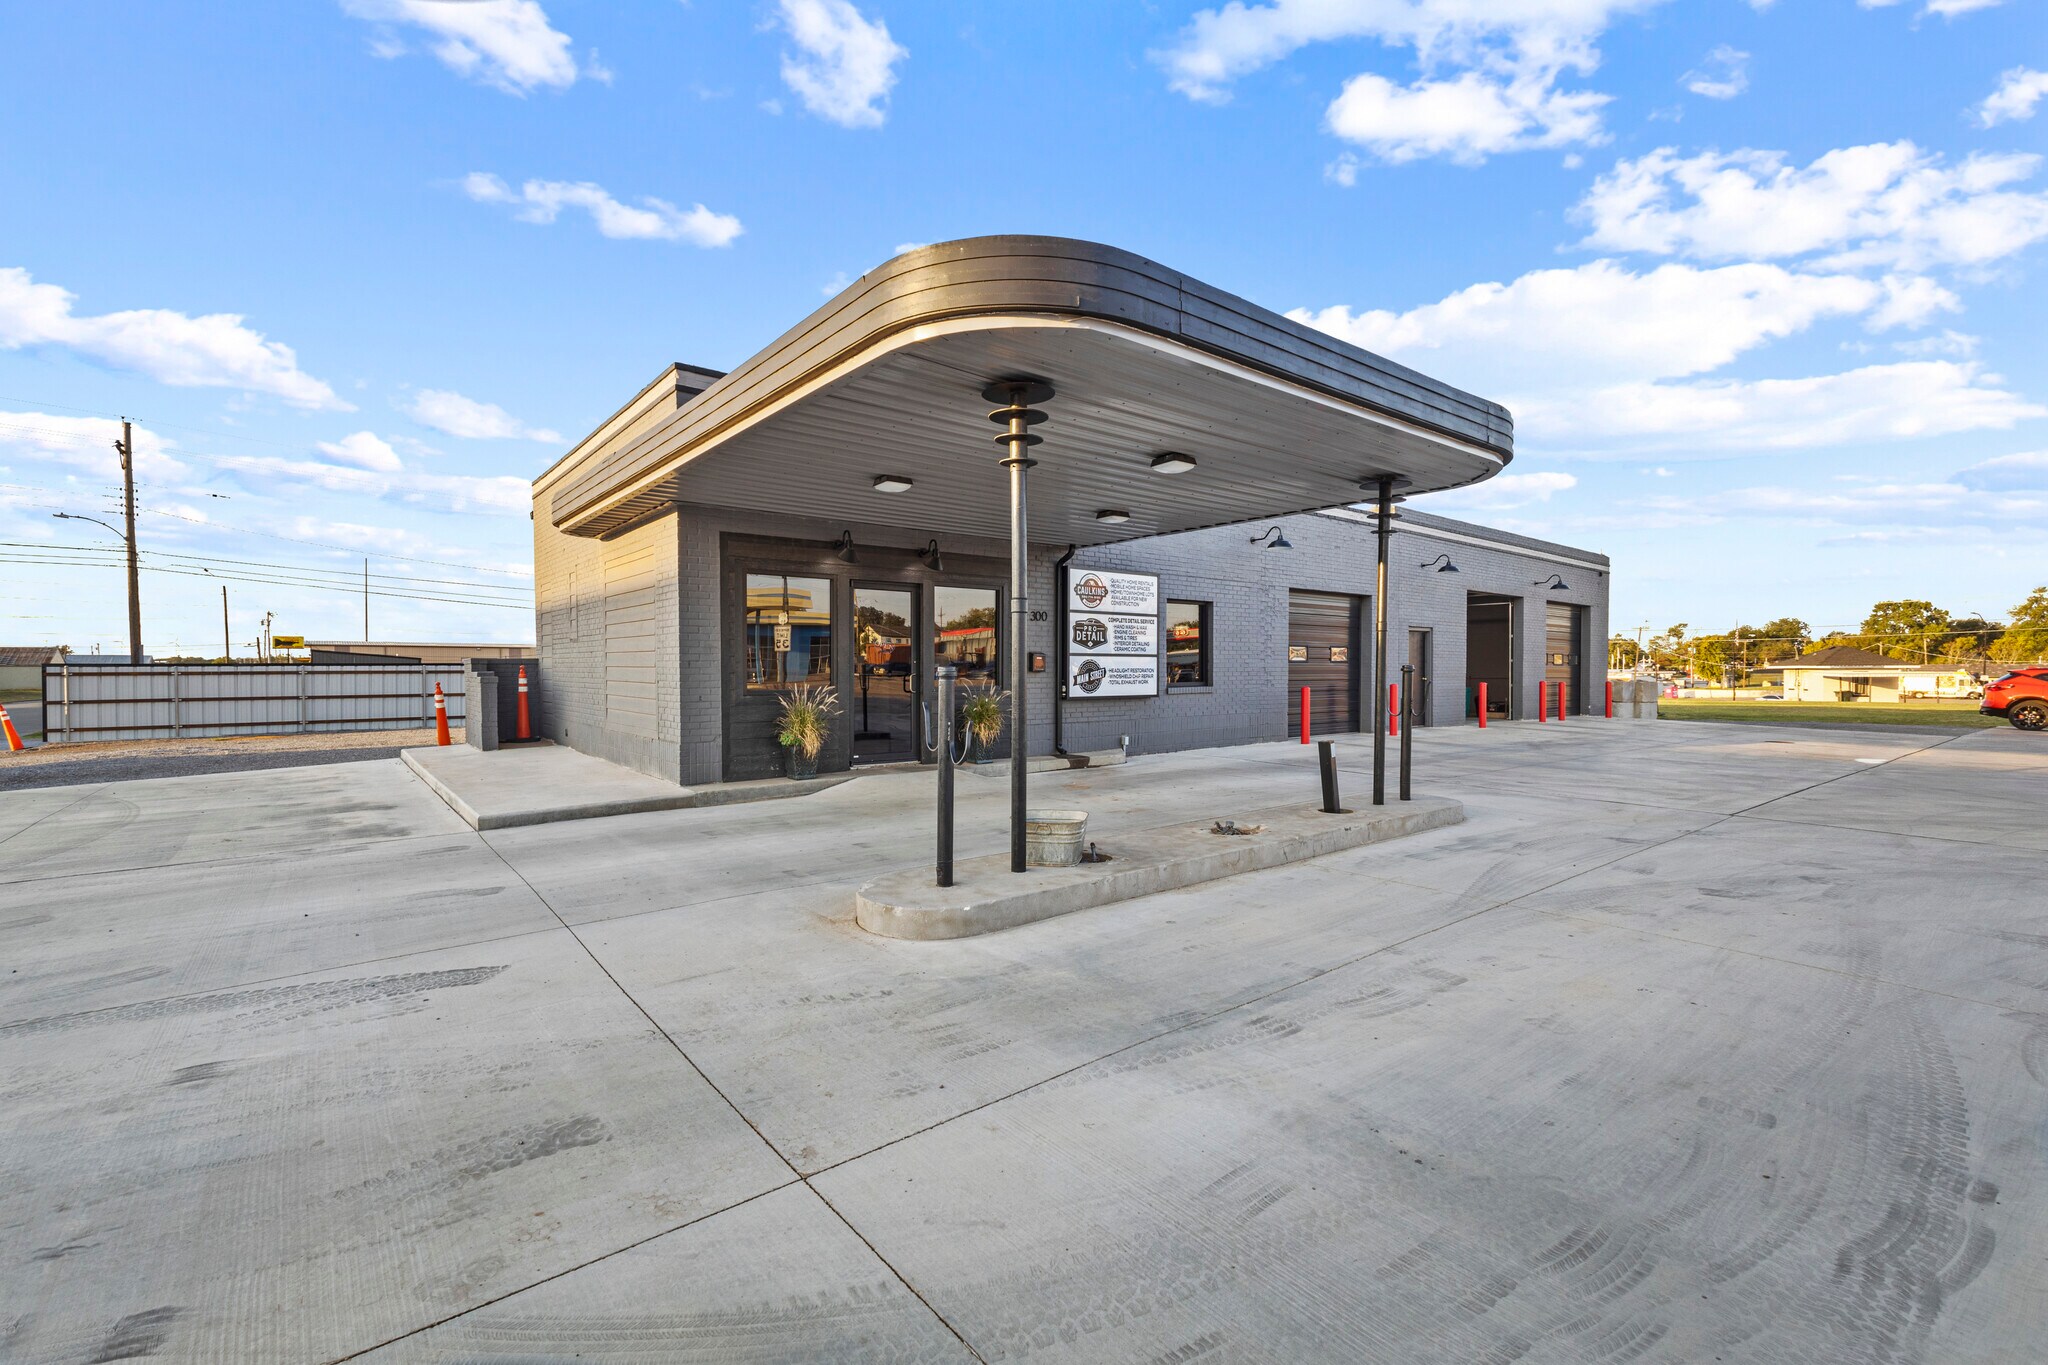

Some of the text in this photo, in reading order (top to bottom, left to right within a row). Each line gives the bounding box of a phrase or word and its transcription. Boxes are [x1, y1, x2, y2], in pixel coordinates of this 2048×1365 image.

[1077, 586, 1106, 596] CAULKINS
[1030, 611, 1048, 621] 300
[1076, 631, 1104, 641] DETAIL
